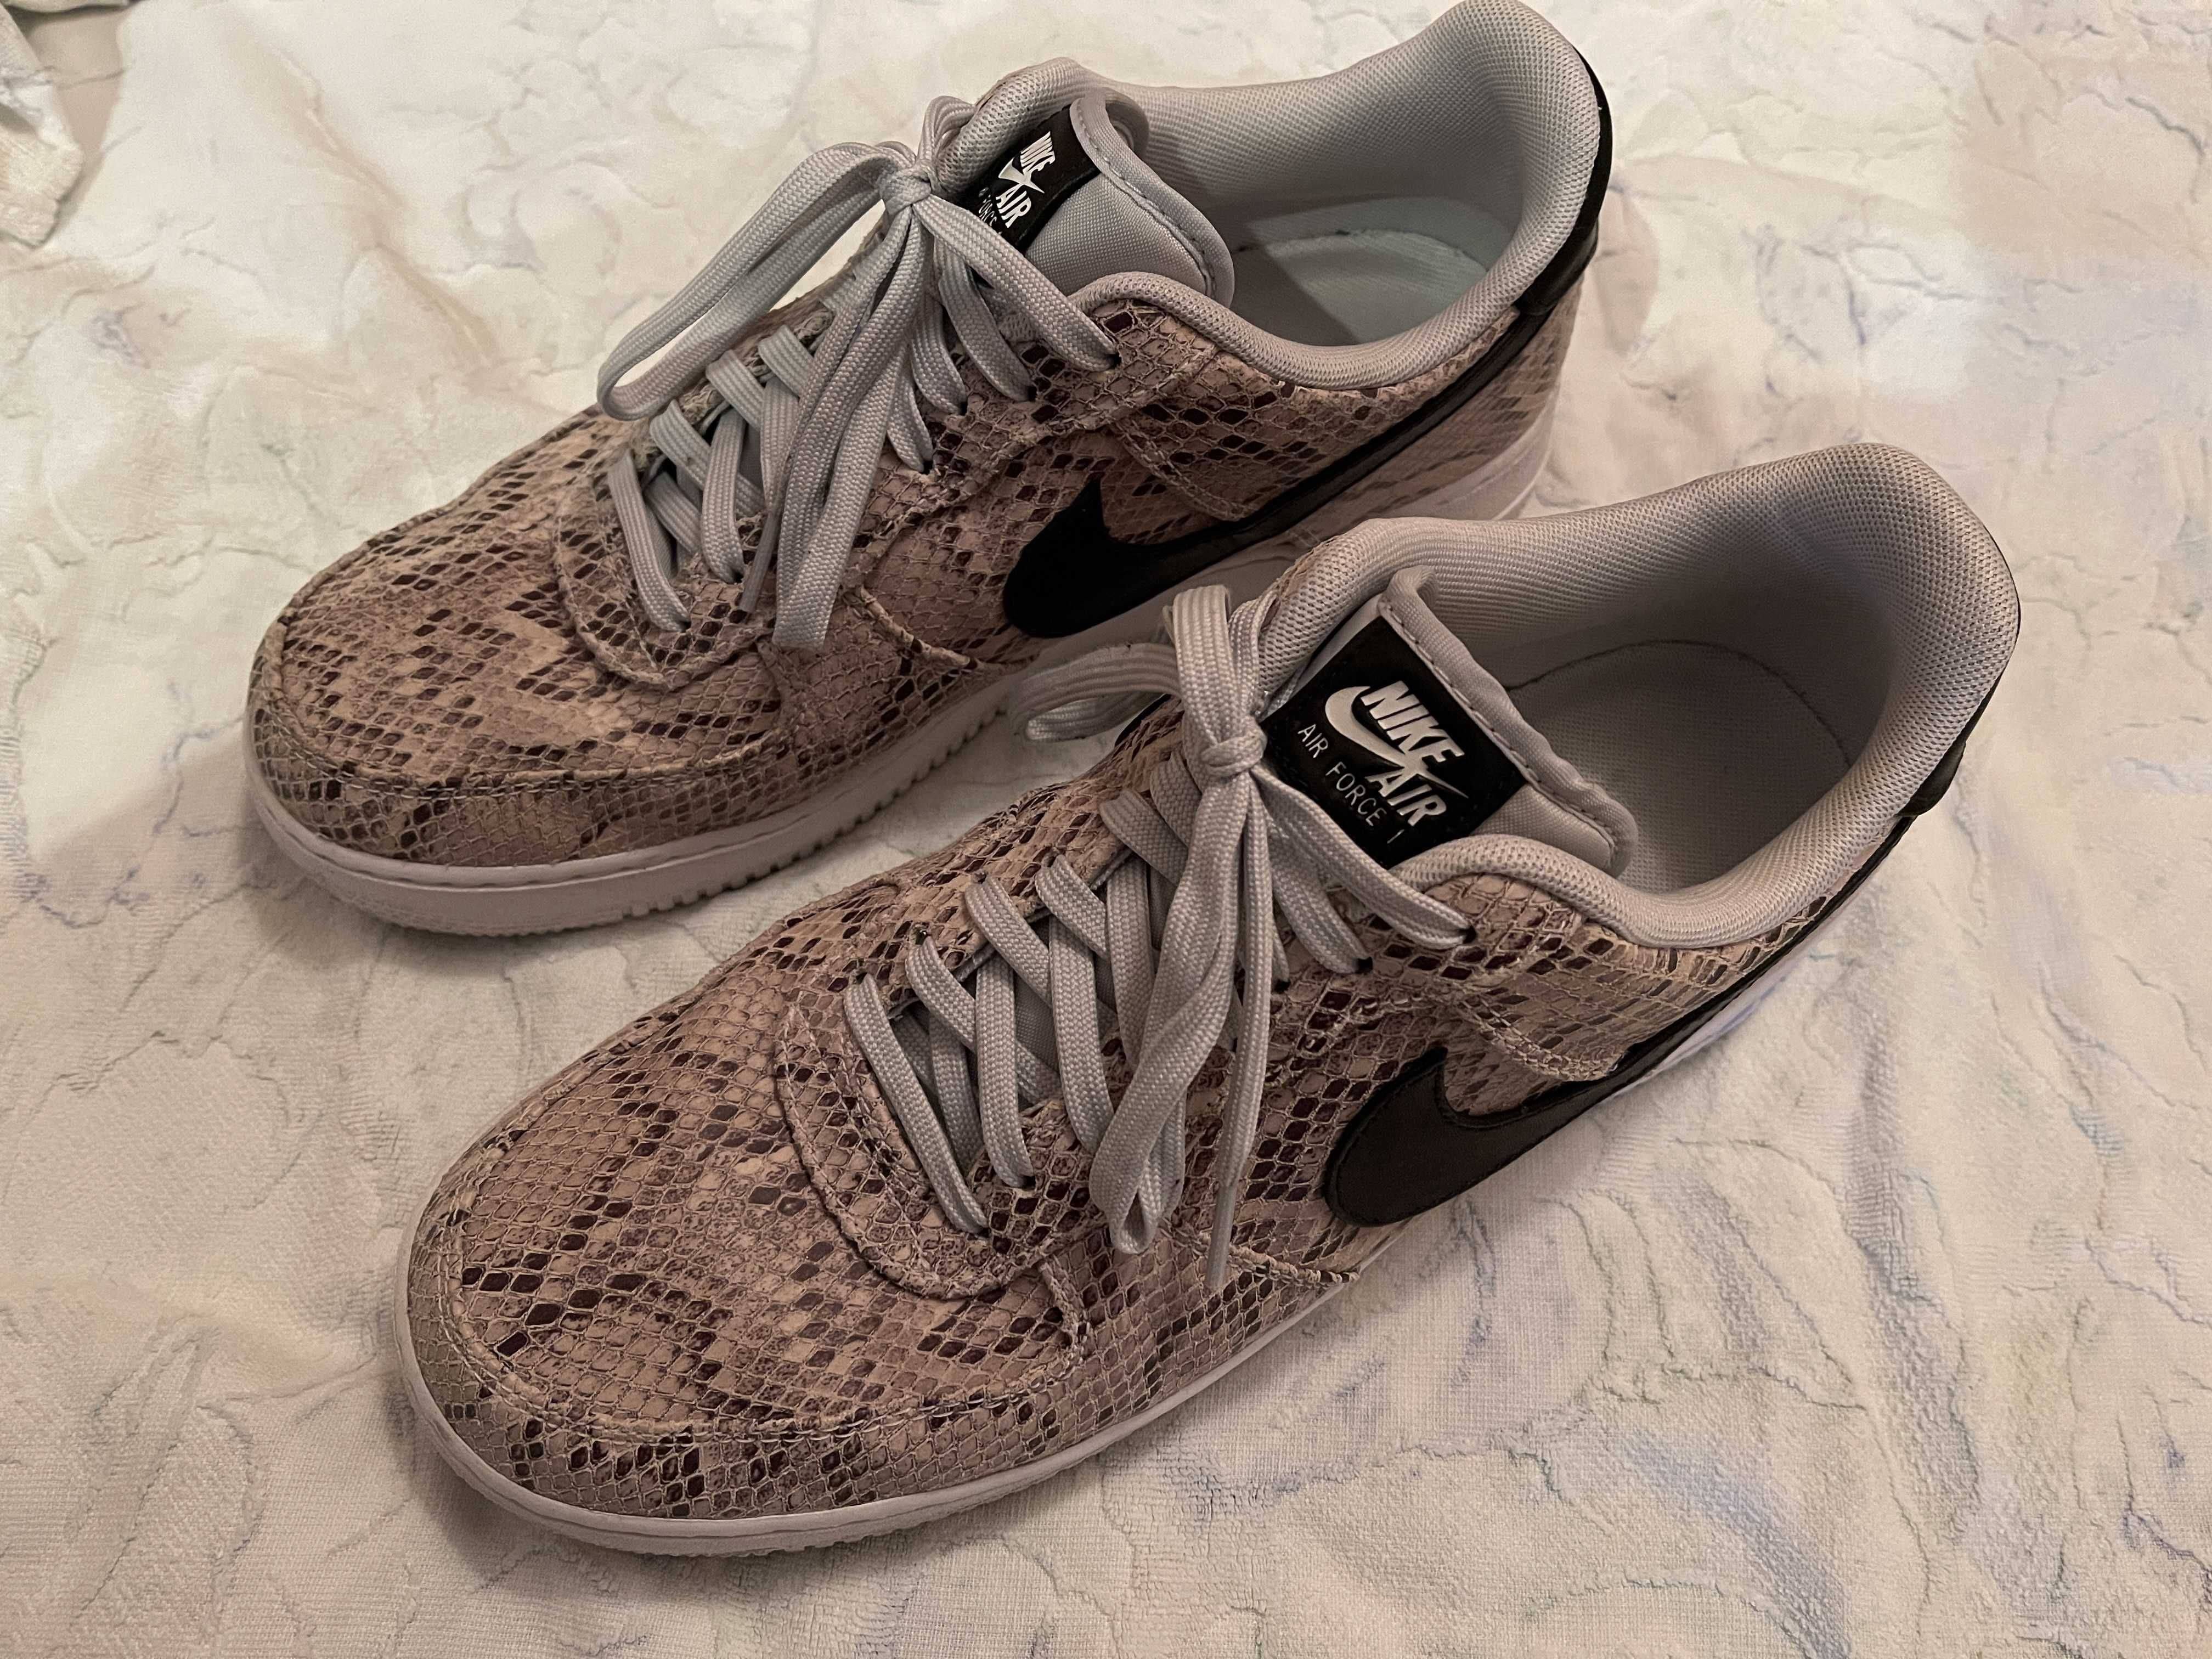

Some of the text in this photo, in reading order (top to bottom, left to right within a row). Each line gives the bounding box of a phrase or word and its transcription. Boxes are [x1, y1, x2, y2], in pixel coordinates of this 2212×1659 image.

[996, 184, 1031, 228] AIR
[1361, 680, 1465, 768] NIKE
[1297, 724, 1328, 758] AIR
[1325, 761, 1387, 826] FORCE
[1365, 770, 1447, 826] AIR
